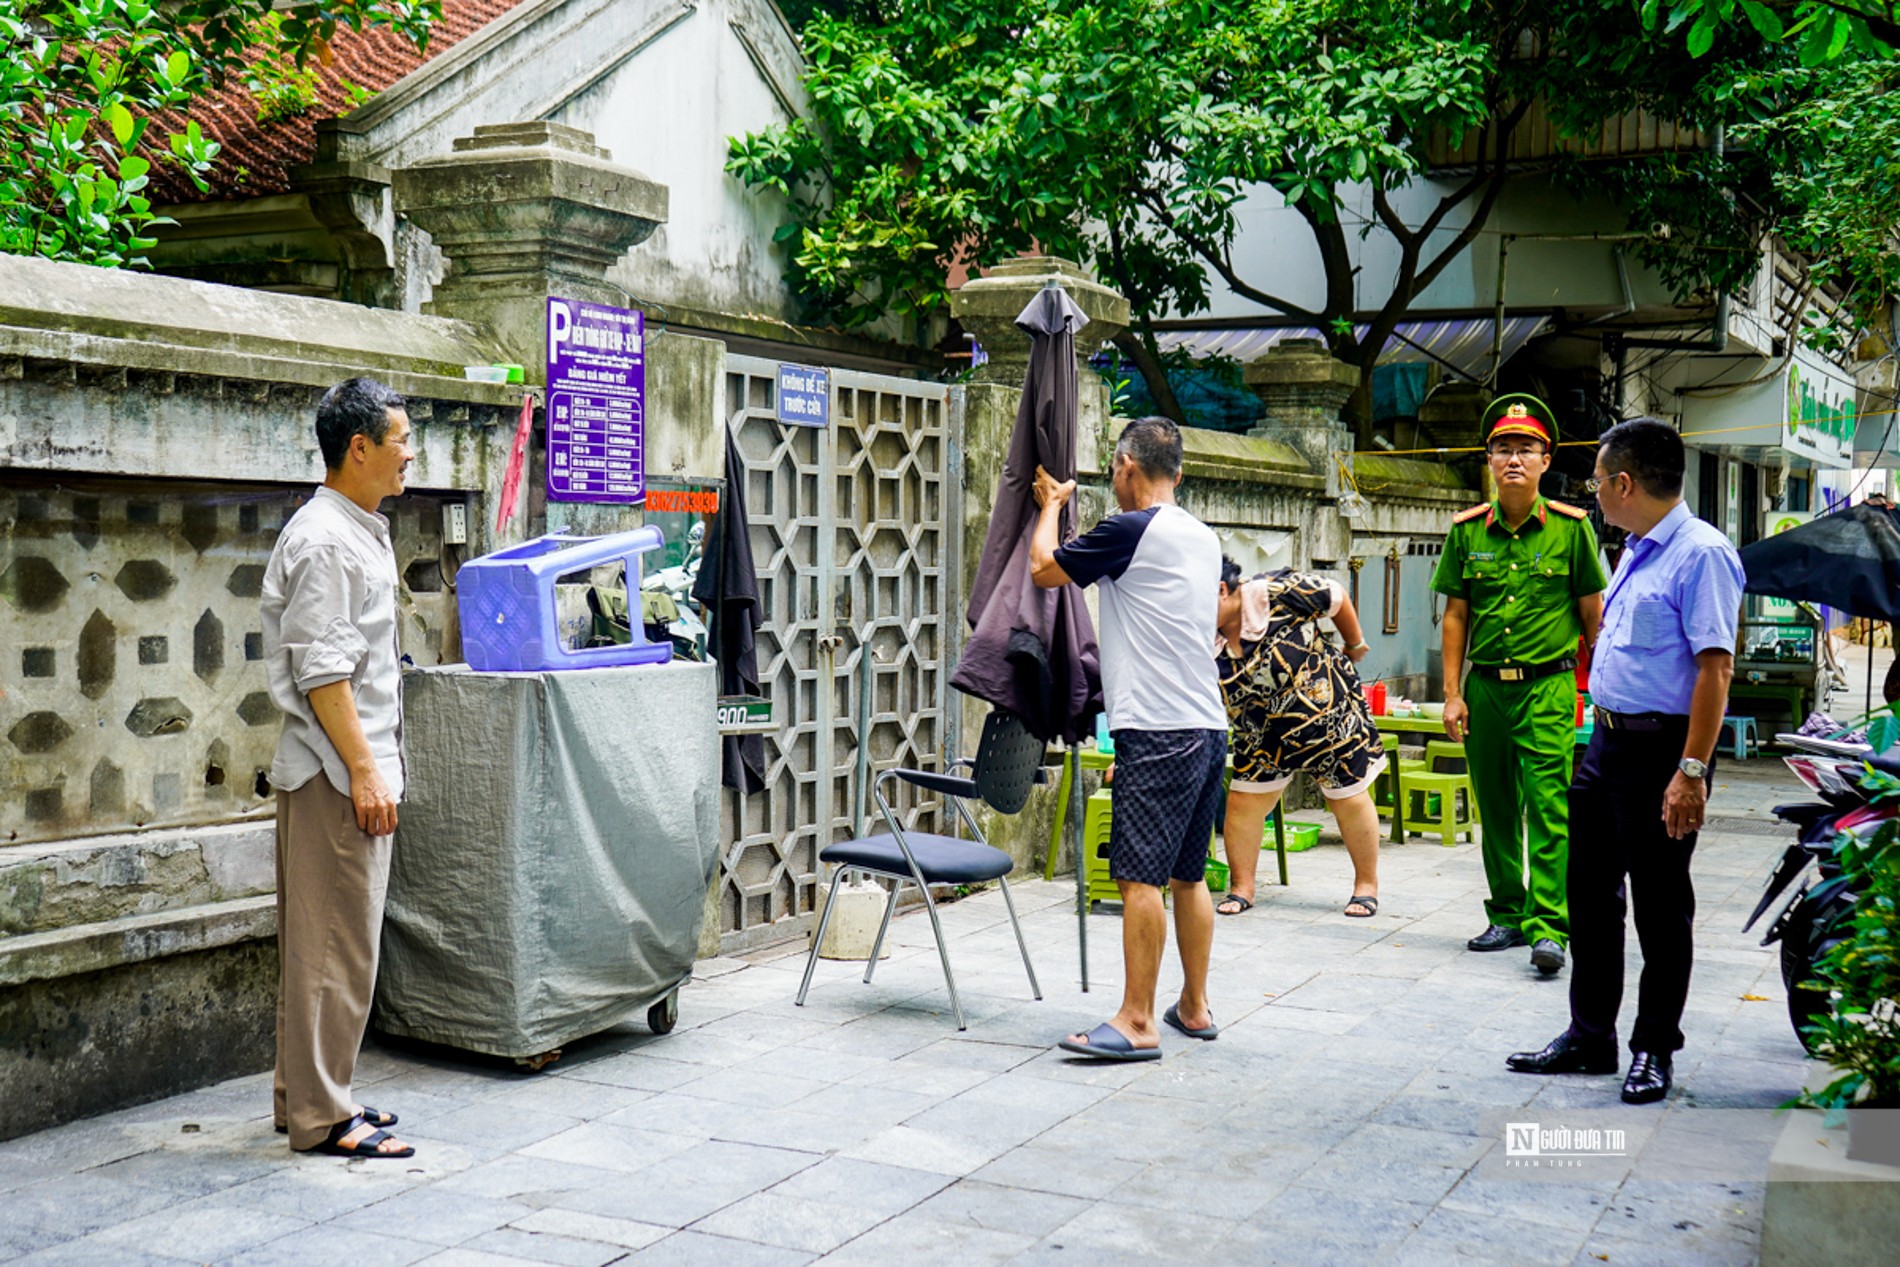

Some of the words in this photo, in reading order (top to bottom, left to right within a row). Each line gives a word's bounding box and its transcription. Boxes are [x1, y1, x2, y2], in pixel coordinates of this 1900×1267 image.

[550, 300, 572, 364] P
[568, 365, 586, 379] BẢNG
[587, 369, 597, 381] GIÁ
[598, 370, 615, 383] NIÊM
[616, 372, 627, 385] YẾT
[782, 373, 805, 392] KHÔNG
[806, 373, 816, 393] ĐỂ
[816, 380, 826, 395] XE
[784, 395, 806, 414] TRƯỚC
[807, 395, 822, 416] CỬA
